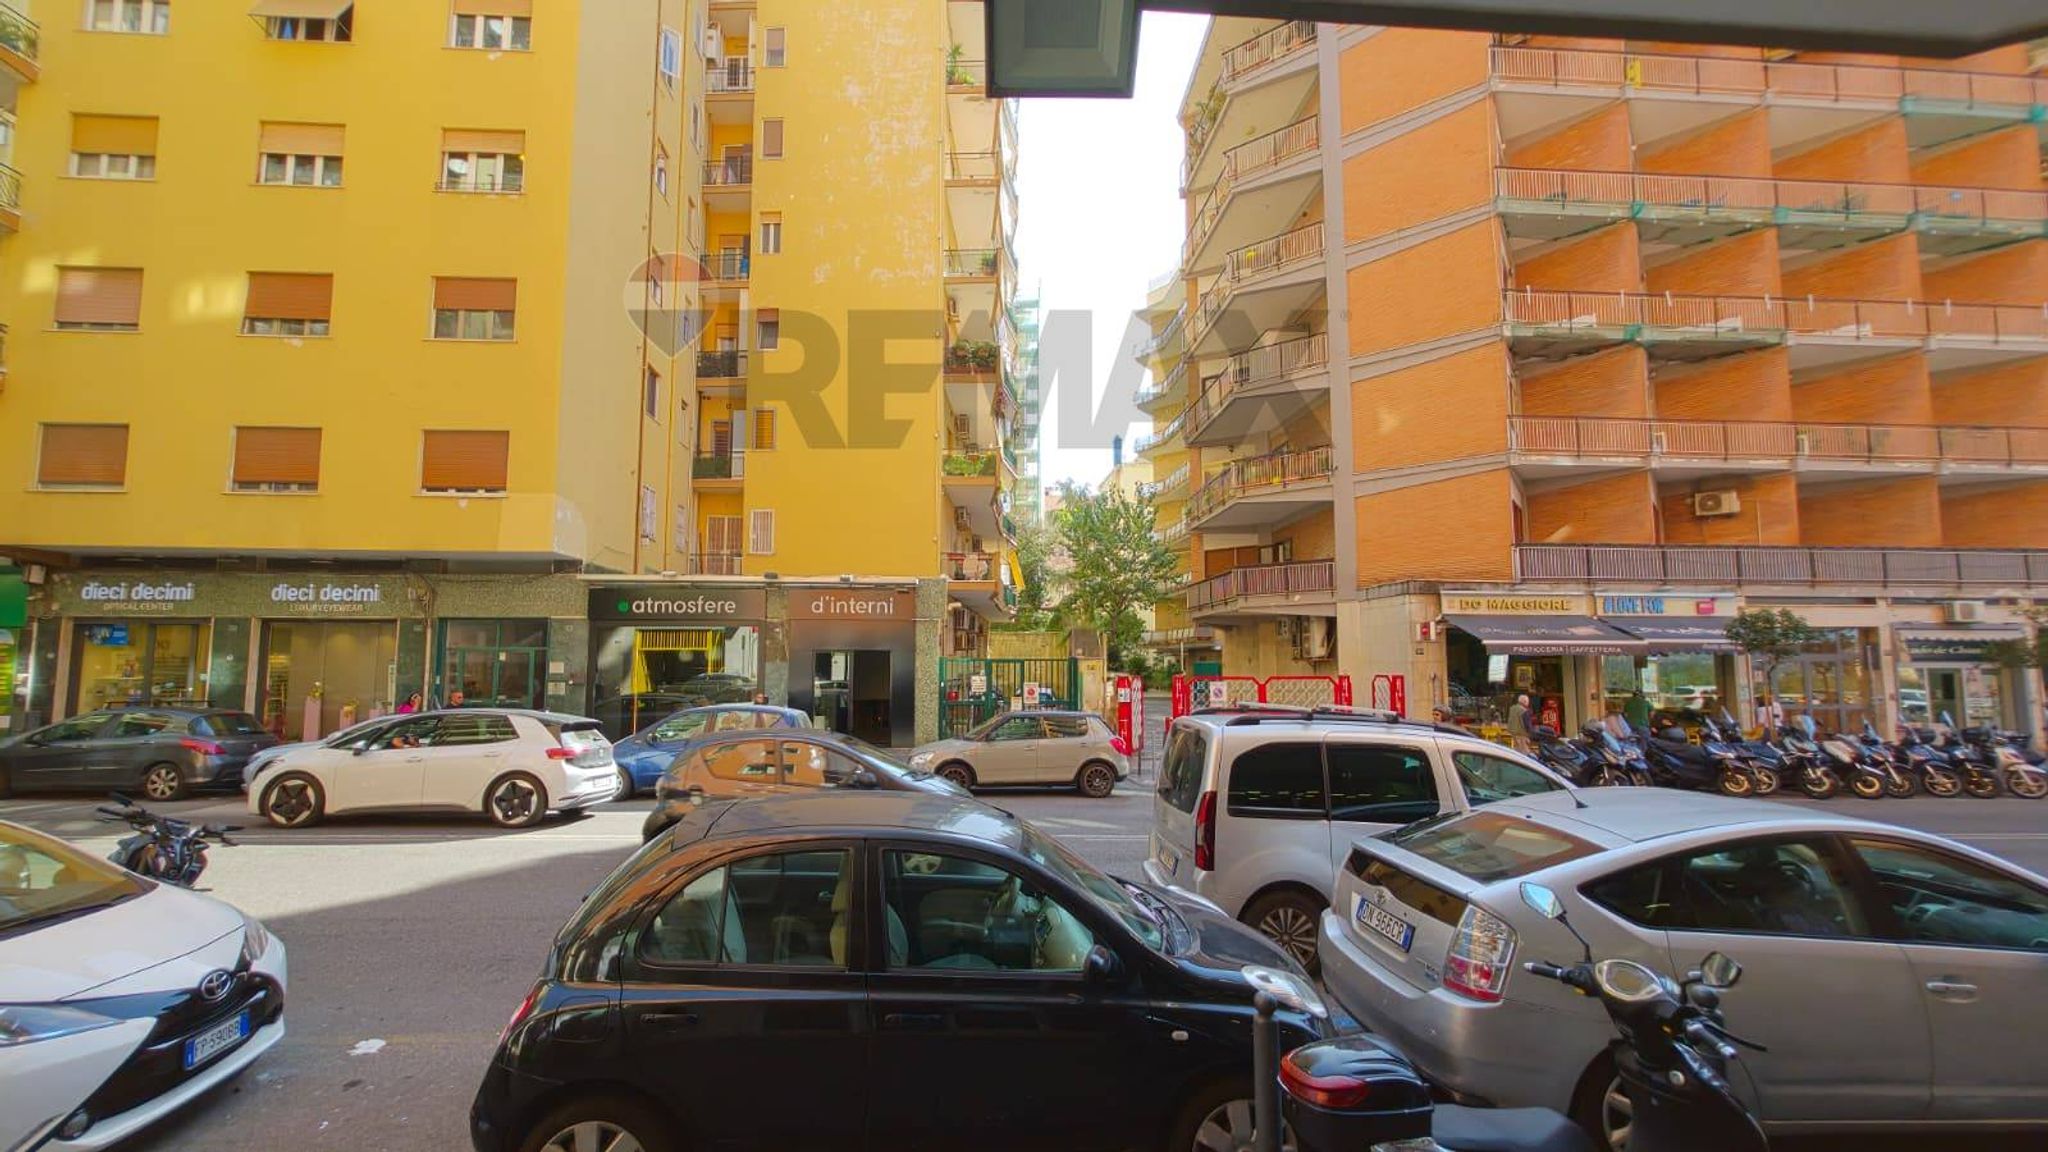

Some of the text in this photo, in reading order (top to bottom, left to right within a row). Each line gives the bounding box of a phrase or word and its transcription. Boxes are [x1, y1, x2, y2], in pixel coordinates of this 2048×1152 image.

[81, 582, 194, 600] dieci decimi
[271, 584, 379, 601] dieci decimi
[103, 603, 138, 611] OPTICAL
[632, 596, 736, 613] atmosfere
[811, 597, 894, 614] d'interni
[1487, 599, 1572, 611] MAGGIORE
